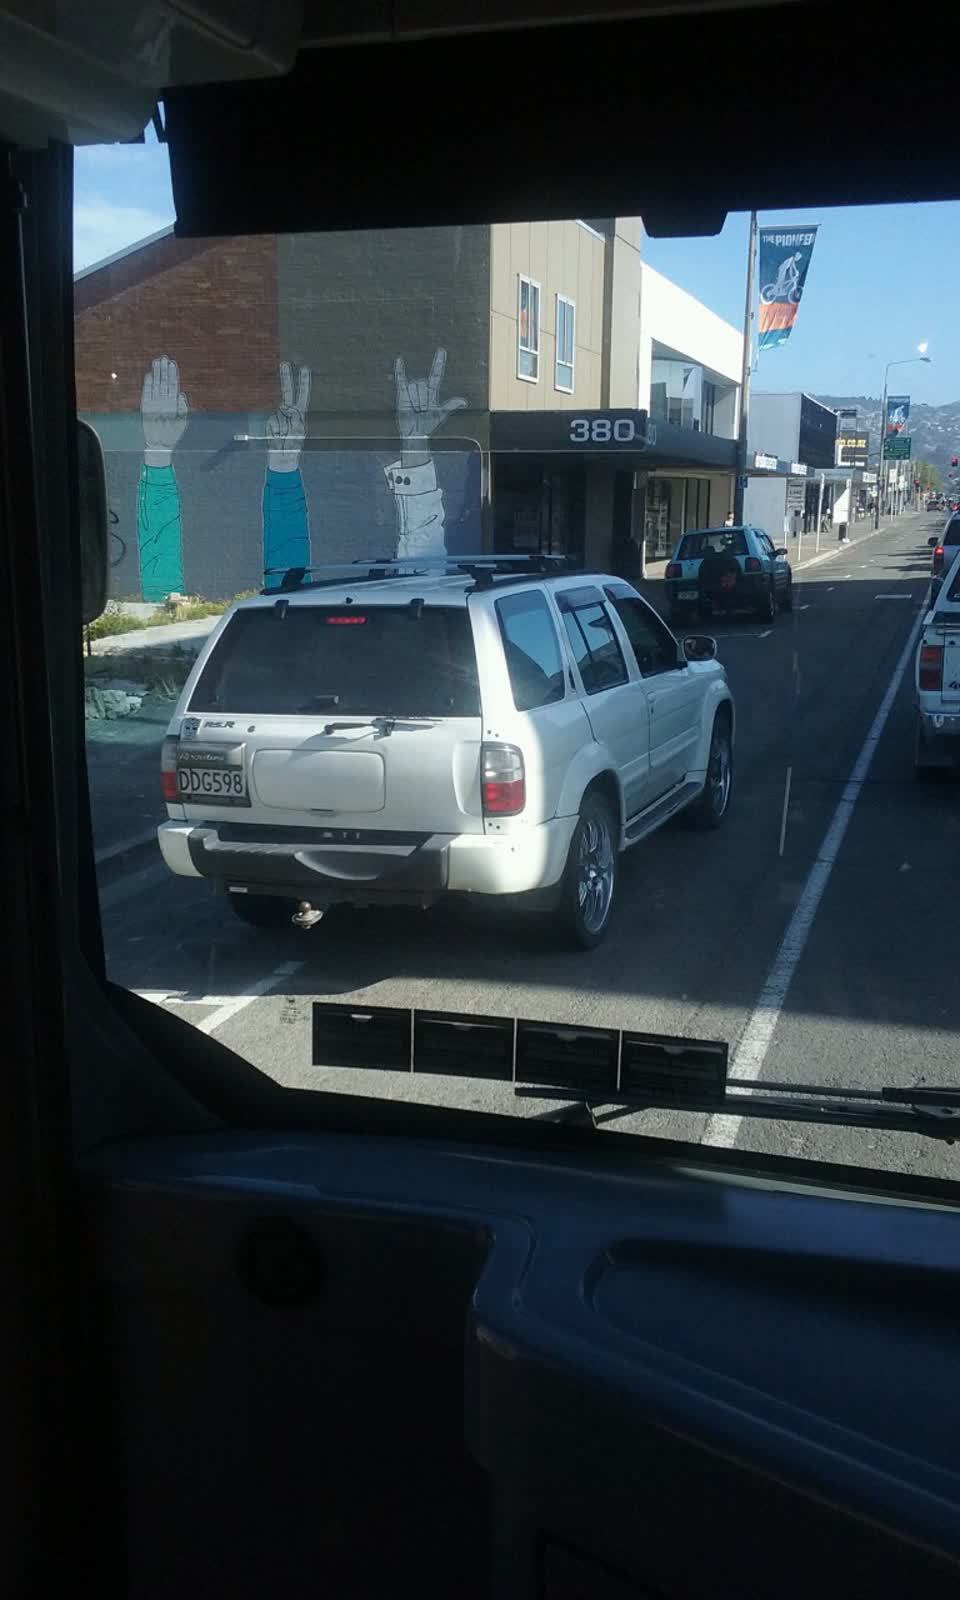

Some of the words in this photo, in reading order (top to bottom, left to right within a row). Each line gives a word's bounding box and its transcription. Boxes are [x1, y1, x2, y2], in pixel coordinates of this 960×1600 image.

[763, 234, 776, 244] THE
[570, 419, 635, 442] 380
[179, 770, 243, 794] DDG598
